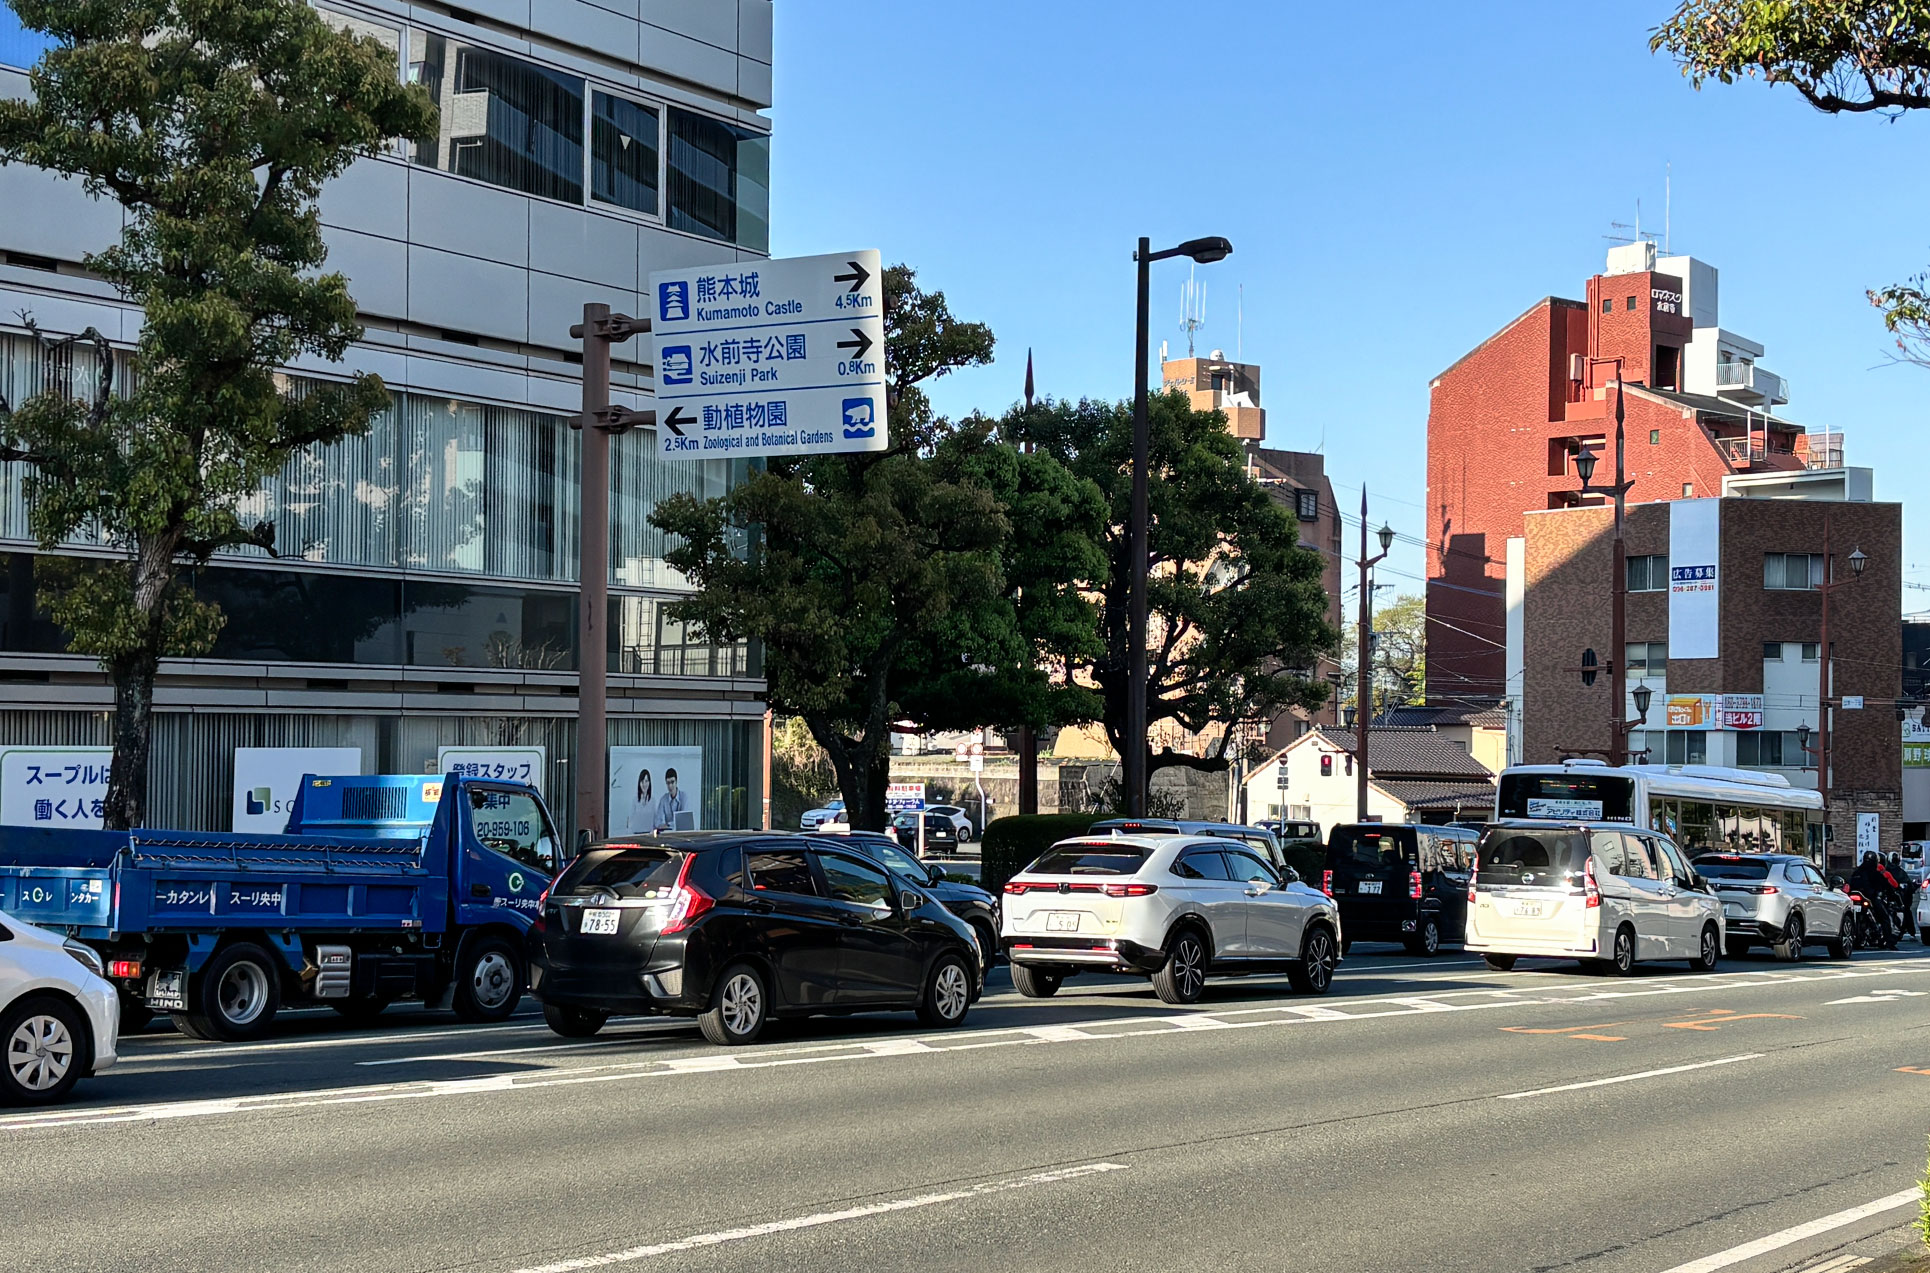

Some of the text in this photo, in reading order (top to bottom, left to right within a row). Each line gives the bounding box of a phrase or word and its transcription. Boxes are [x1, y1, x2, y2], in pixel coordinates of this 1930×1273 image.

[696, 272, 760, 304] 熊本城
[697, 299, 803, 322] Kumamoto Castle
[835, 294, 873, 310] 4.5Km
[699, 333, 807, 368] 水前寺公園
[700, 367, 778, 386] Suizenji Park
[838, 360, 876, 376] 0.8Km
[702, 400, 788, 431] 動植物園
[664, 437, 699, 452] 2.5Km
[703, 430, 834, 451] Zoological and Botanical Gardens
[1673, 566, 1714, 580] 広告募集
[589, 919, 616, 932] 78-55
[150, 998, 183, 1009] HINO
